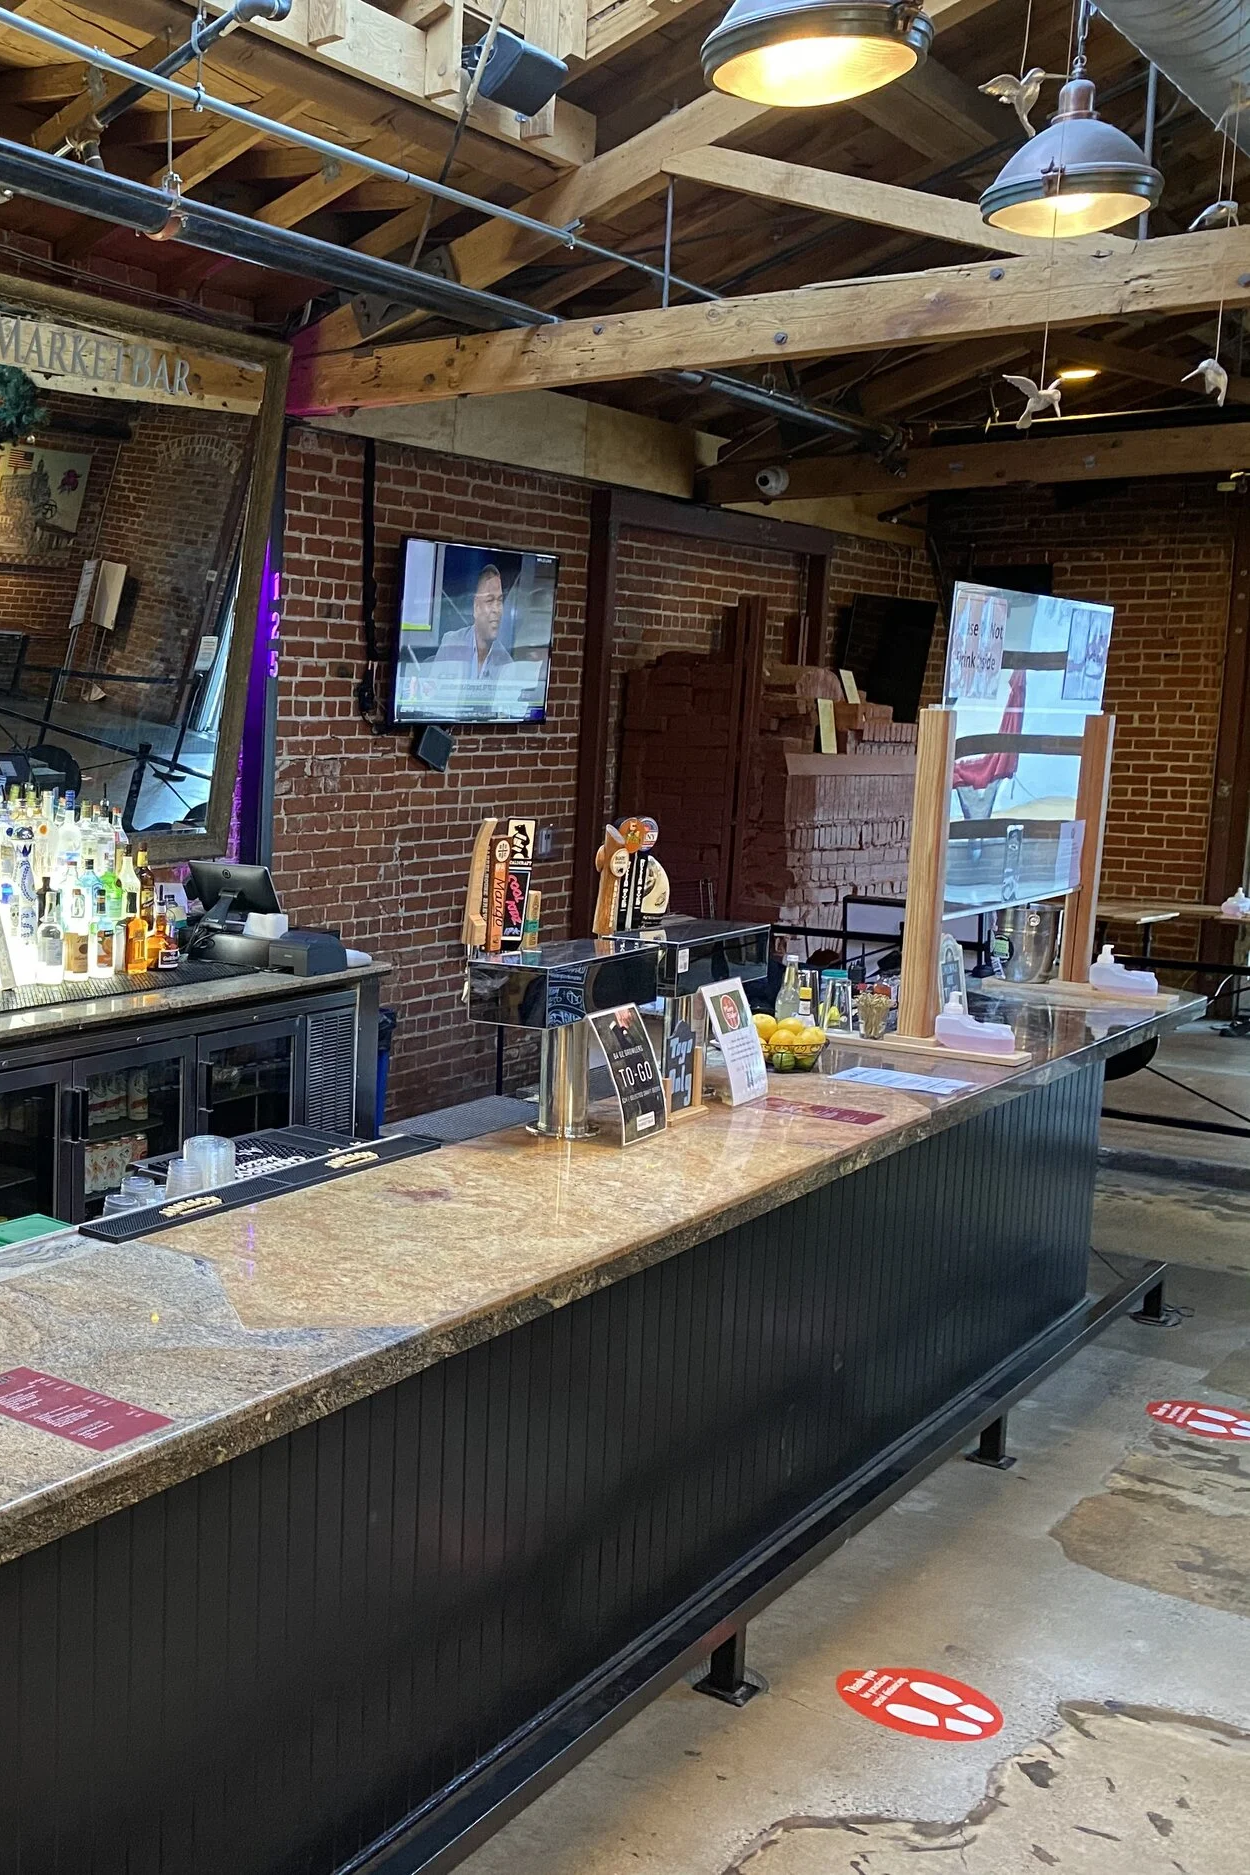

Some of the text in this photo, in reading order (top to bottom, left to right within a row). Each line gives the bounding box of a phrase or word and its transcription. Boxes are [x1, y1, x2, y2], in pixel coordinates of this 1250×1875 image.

[130, 344, 191, 396] BAR
[493, 878, 506, 927] Mango
[618, 1061, 653, 1088] TO-GO
